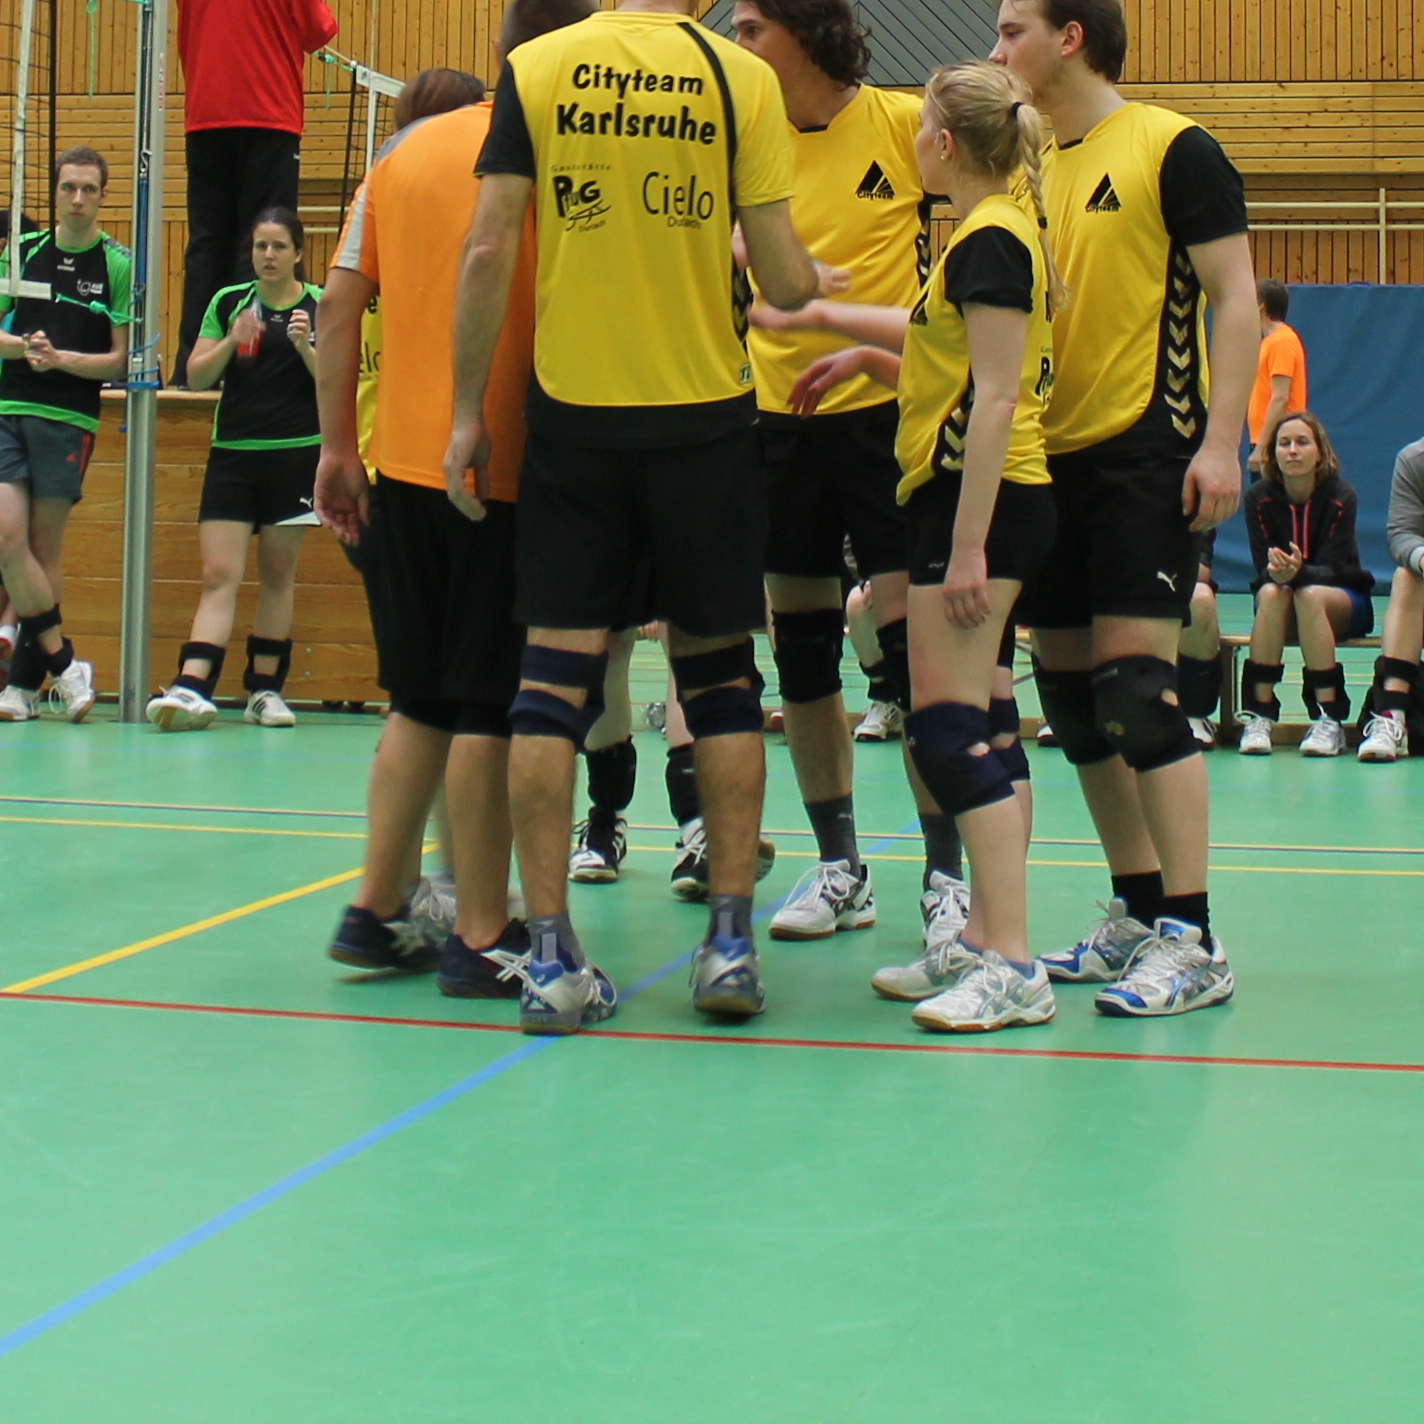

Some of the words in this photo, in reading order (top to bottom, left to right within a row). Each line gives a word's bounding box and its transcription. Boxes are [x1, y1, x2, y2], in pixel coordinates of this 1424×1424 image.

[572, 63, 703, 98] Cityteam
[557, 103, 716, 145] Karlsruhe
[643, 171, 714, 220] Cielo
